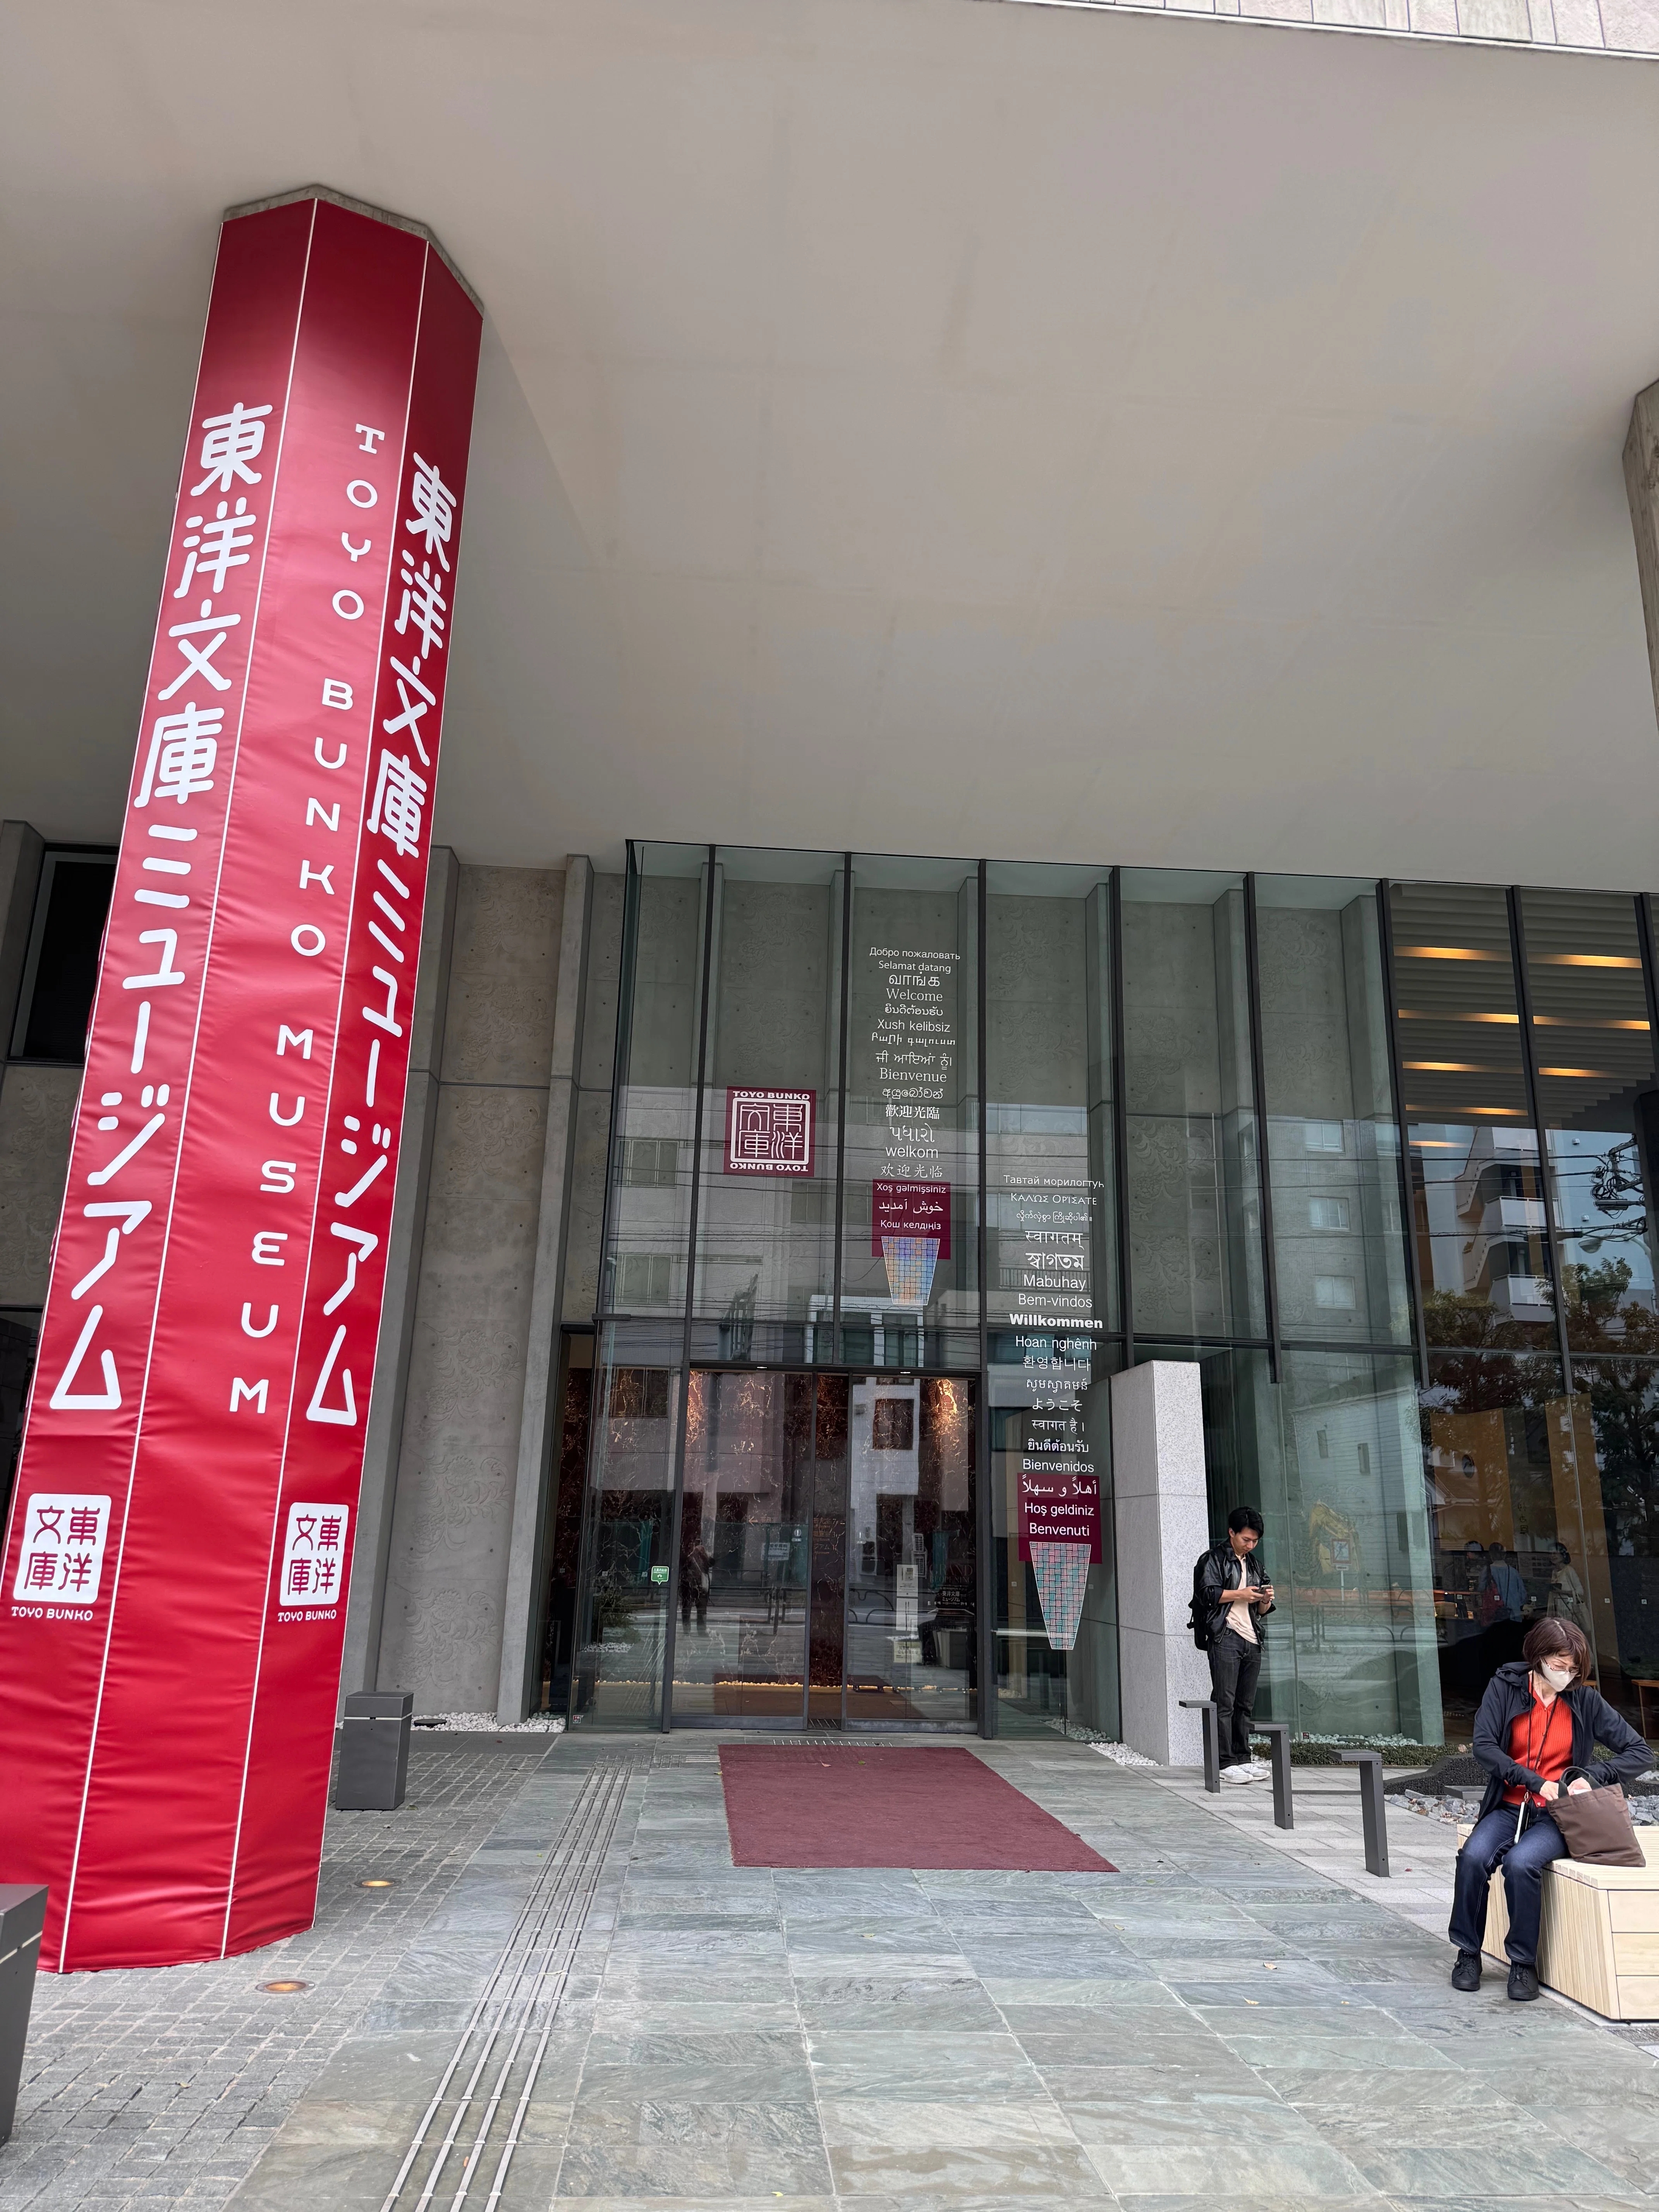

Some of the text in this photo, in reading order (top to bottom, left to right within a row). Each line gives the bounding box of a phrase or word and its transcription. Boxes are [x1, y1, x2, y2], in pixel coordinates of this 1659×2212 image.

[50, 402, 273, 1410] 東洋文庫ミュージアム
[229, 423, 385, 1414] TOYO BUNKO MUSEUM
[306, 452, 457, 1426] 東洋文庫ミュージアム
[869, 947, 960, 960] Добро пожаловать
[879, 960, 951, 974] Selamat datang
[886, 988, 943, 1001] Welcome
[877, 1019, 950, 1032] Xush kelibsiz
[879, 1067, 947, 1082] Bienvenue
[885, 1104, 940, 1120] 歡迎光臨
[885, 1145, 938, 1159] welkom
[880, 1163, 943, 1179] 欢迎光临
[1003, 1175, 1039, 1185] Тавтай
[877, 1183, 946, 1194] Xoş gəlmişsiniz
[913, 1201, 943, 1214] خوش
[881, 1219, 900, 1229] Қош
[1025, 1231, 1085, 1251] स्वागतम्
[1025, 1252, 1084, 1271] স্বাগতম
[1024, 1274, 1086, 1292] Mabuhay
[1018, 1293, 1092, 1308] Bem-vindos
[1009, 1314, 1103, 1329] Willkommen
[1015, 1336, 1097, 1352] Hoan nghênh
[1023, 1355, 1091, 1371] 환영합니다
[1032, 1398, 1083, 1412] ようこそ
[1031, 1420, 1066, 1431] स्वागत
[1028, 1438, 1089, 1452] ยินดีต้อนรับ
[1023, 1458, 1094, 1472] Bienvenidos
[1025, 1502, 1094, 1517] Hoş geldiniz
[1030, 1523, 1089, 1536] Benvenuti
[11, 1606, 93, 1621] TOYO BUNKO
[278, 1609, 337, 1622] TOYO BUNKO
